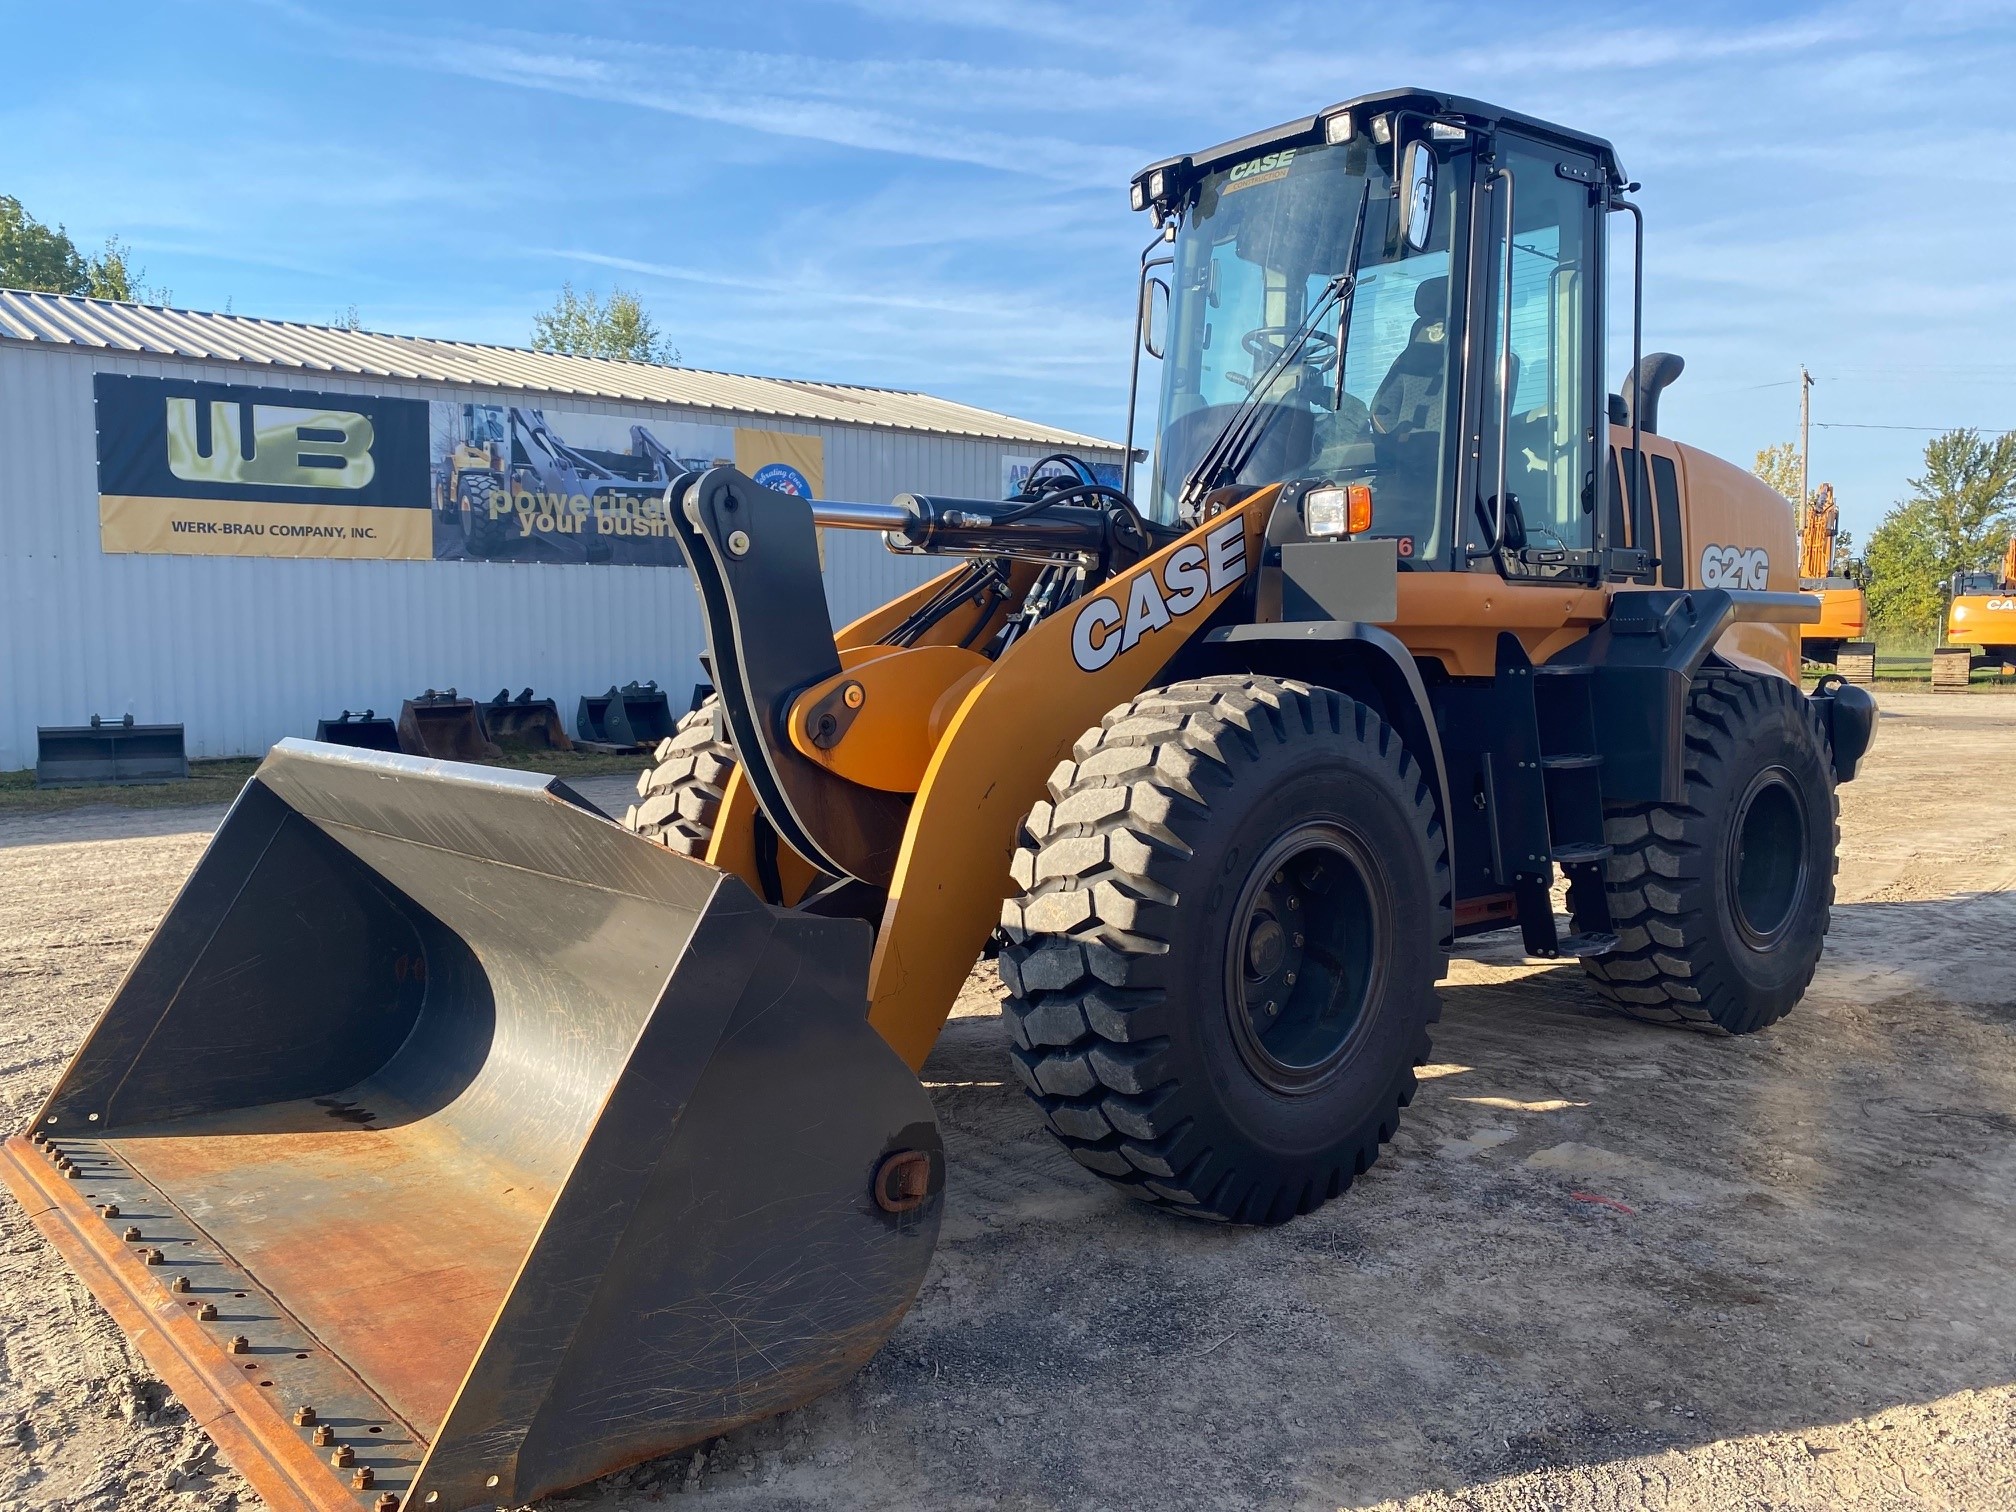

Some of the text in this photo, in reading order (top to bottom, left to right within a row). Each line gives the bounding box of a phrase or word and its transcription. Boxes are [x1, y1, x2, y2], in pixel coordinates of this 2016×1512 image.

[1230, 149, 1297, 181] CASE
[1232, 169, 1287, 190] CONSTRUCTION
[488, 488, 662, 524] powering
[171, 520, 377, 539] WERK-BRAU COMPANY, INC.
[519, 510, 675, 538] your busin
[1701, 543, 1769, 591] 621G
[1071, 513, 1248, 673] CASE
[1986, 599, 2016, 611] CA
